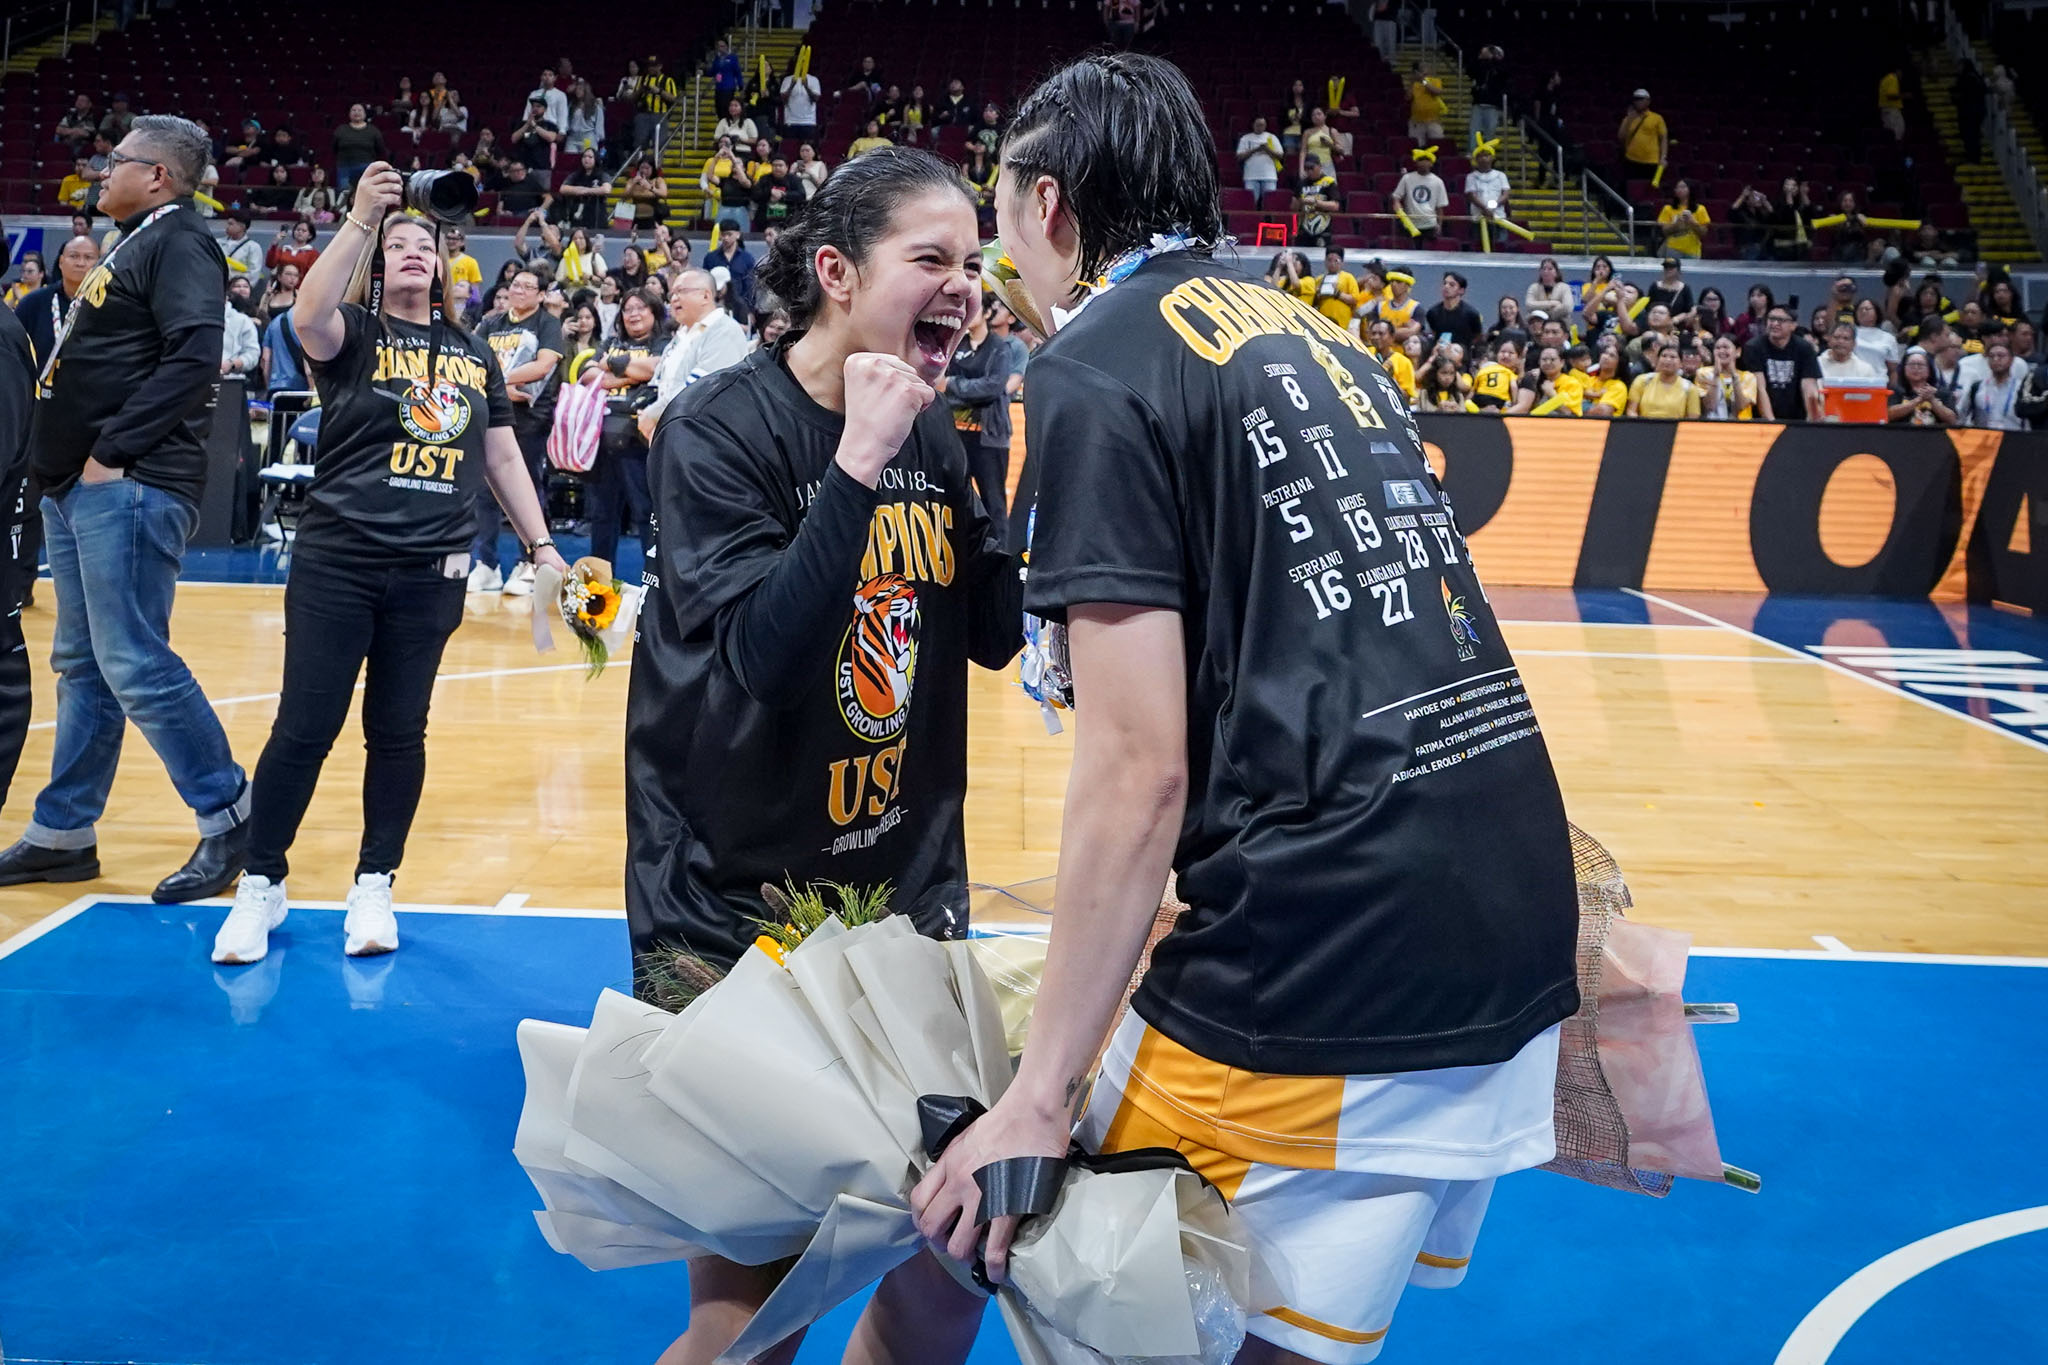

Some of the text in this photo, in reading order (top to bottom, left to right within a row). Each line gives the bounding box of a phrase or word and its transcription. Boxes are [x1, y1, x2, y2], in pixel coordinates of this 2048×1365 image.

[370, 280, 382, 316] SONY
[1160, 277, 1382, 366] CHAMPION
[1282, 376, 1309, 411] 8
[1486, 372, 1498, 387] 8
[405, 419, 449, 441] GROWLING
[449, 405, 468, 435] TIGERS
[1241, 406, 1268, 431] BRON
[1300, 424, 1334, 443] SANTOS
[390, 442, 464, 481] UST
[1247, 420, 1288, 469] 15
[1313, 439, 1349, 480] 11
[1262, 476, 1315, 509] PASTRANA
[1336, 492, 1367, 512] AMBOS
[1278, 497, 1314, 544] 5
[1343, 508, 1382, 553] 19
[860, 501, 955, 587] MPIONS
[1395, 529, 1430, 570] 28
[1431, 526, 1459, 565] 17
[1288, 550, 1344, 583] SERRANO
[1356, 560, 1407, 588] DANGANAN
[1303, 568, 1352, 620] 16
[1370, 577, 1415, 627] 27
[840, 662, 905, 737] UST GROWLING
[1403, 702, 1439, 721] HAYDEE
[1440, 697, 1456, 712] ONG
[1440, 712, 1465, 729] ALLANA
[1484, 697, 1510, 712] CHARLENE
[1415, 739, 1445, 757] FATIMA
[1445, 730, 1469, 746] CYTHEA
[1392, 764, 1431, 784] ABIGAIL
[1431, 753, 1462, 771] EROLES
